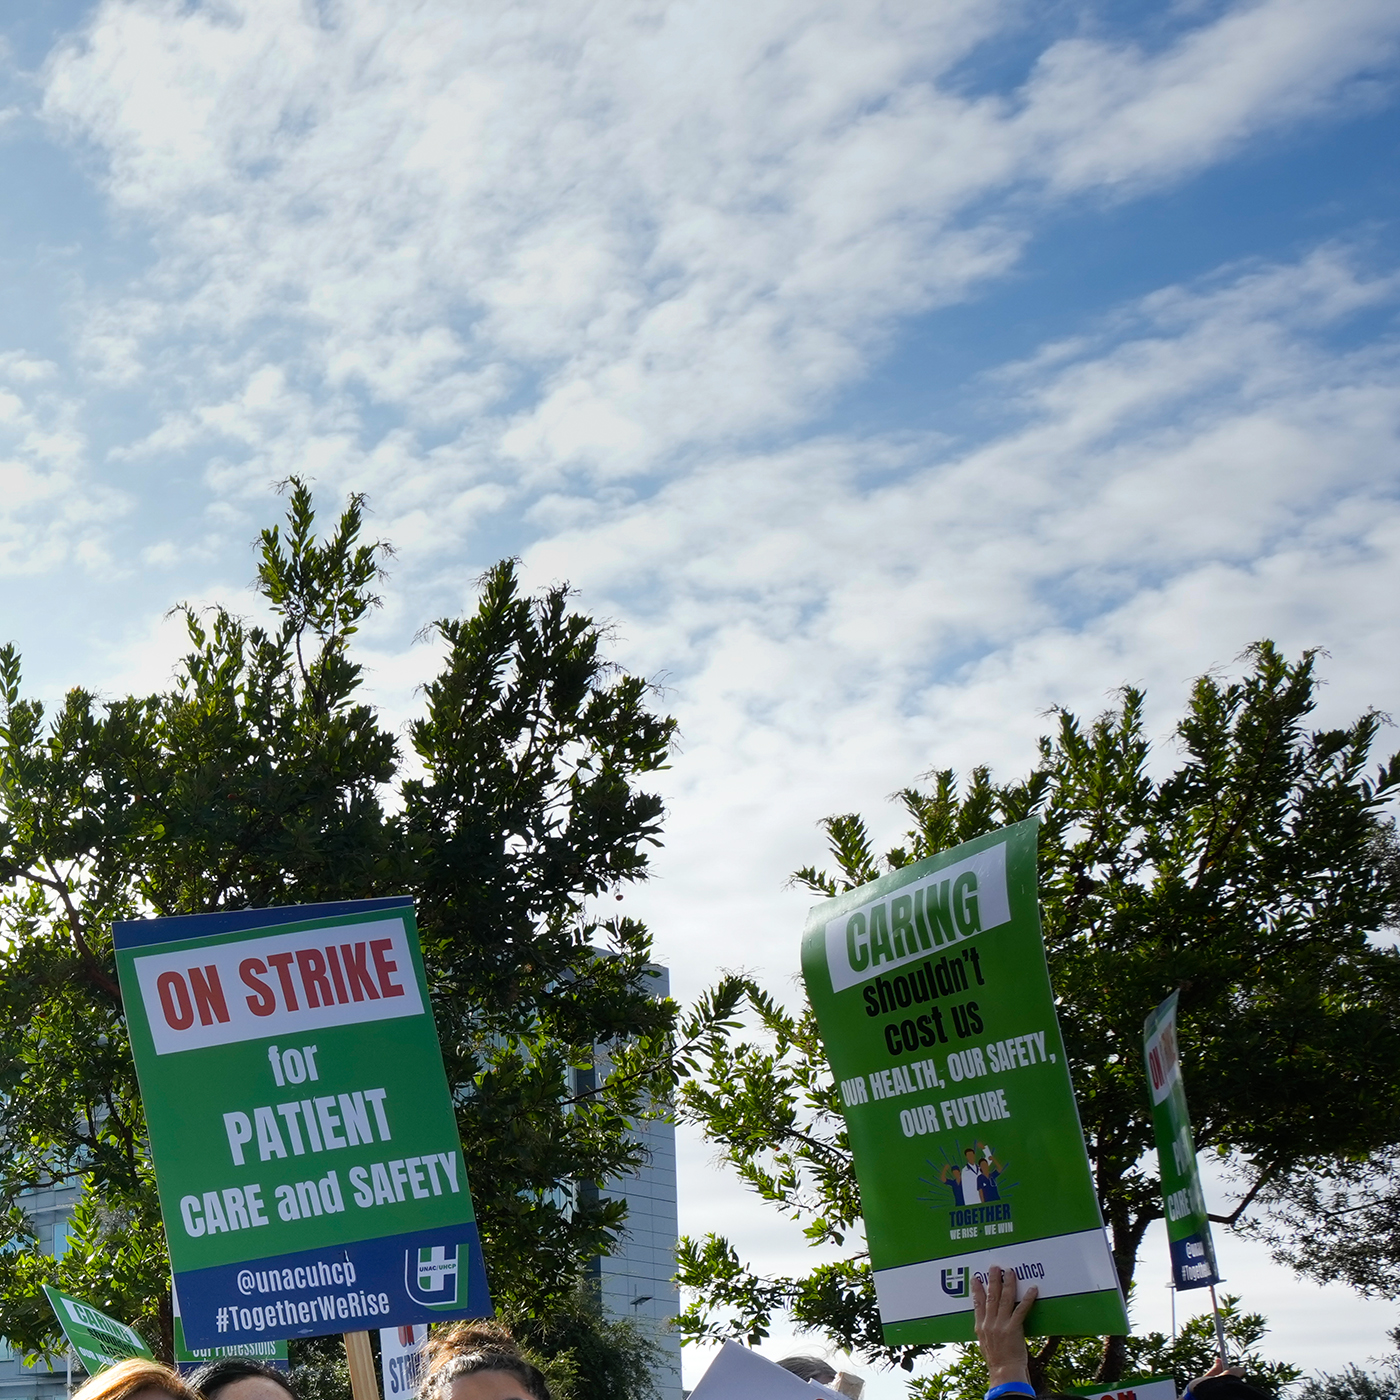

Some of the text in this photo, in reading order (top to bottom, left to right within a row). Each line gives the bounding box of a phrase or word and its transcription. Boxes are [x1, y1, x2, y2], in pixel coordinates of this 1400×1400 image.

[845, 869, 983, 973] CARING
[156, 938, 405, 1031] ON STRIKE
[862, 946, 986, 1018] shouldn't
[884, 1000, 985, 1057] cost us
[267, 1044, 319, 1087] for
[840, 1030, 1057, 1108] OUR HEALTH, OUR SAFETY,
[222, 1088, 391, 1166] PATIENT
[899, 1089, 1011, 1139] OUR FUTURE
[180, 1151, 460, 1239] CARE and SAFETY
[949, 1203, 1011, 1228] TOGETHER
[949, 1221, 1014, 1241] WE RISE WE WIN
[236, 1259, 357, 1295] @unacuhcp
[973, 1262, 1046, 1286] @uuhcp
[215, 1292, 390, 1334] #TogetherWeRise
[389, 1350, 423, 1395] STRI
